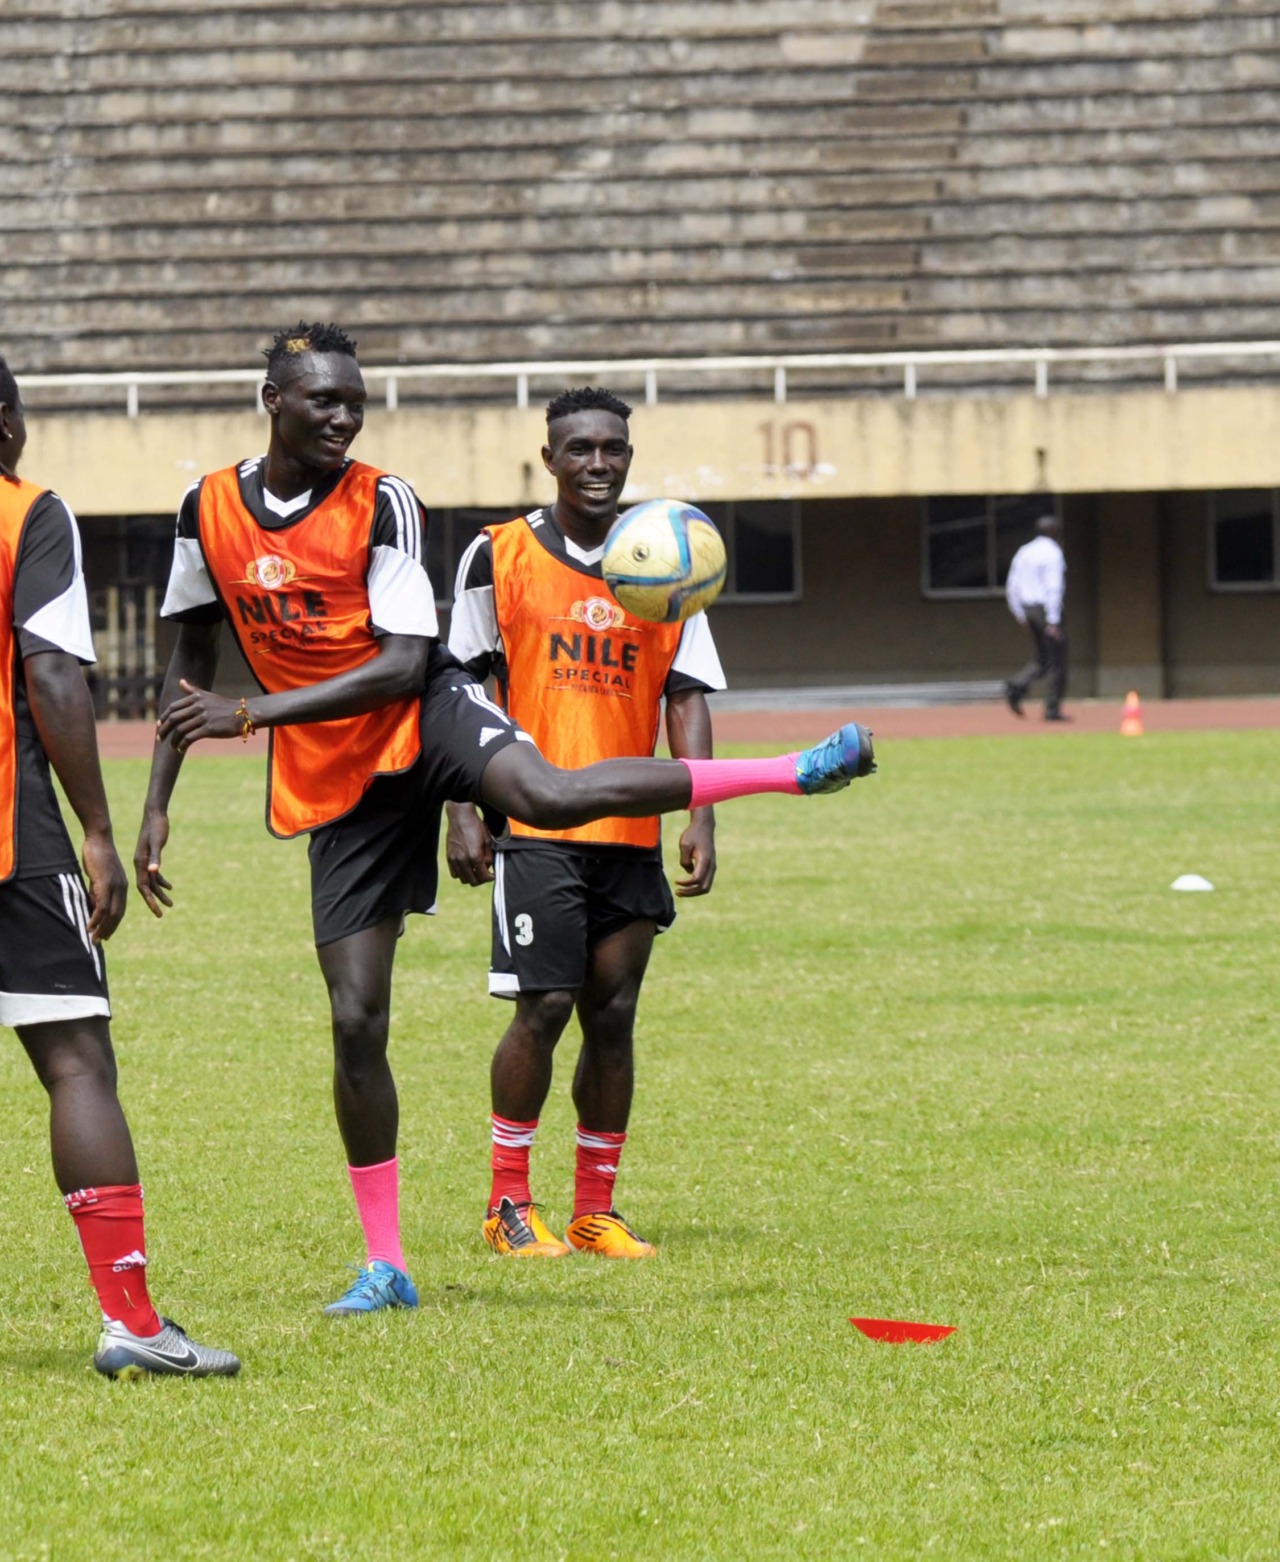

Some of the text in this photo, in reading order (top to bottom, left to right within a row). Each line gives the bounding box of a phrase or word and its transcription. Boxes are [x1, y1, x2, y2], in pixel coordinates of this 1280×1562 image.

[755, 420, 818, 481] 10
[235, 589, 328, 625] NILE
[549, 632, 640, 672] NILE
[553, 668, 631, 689] SPECIAL
[514, 913, 534, 946] 3
